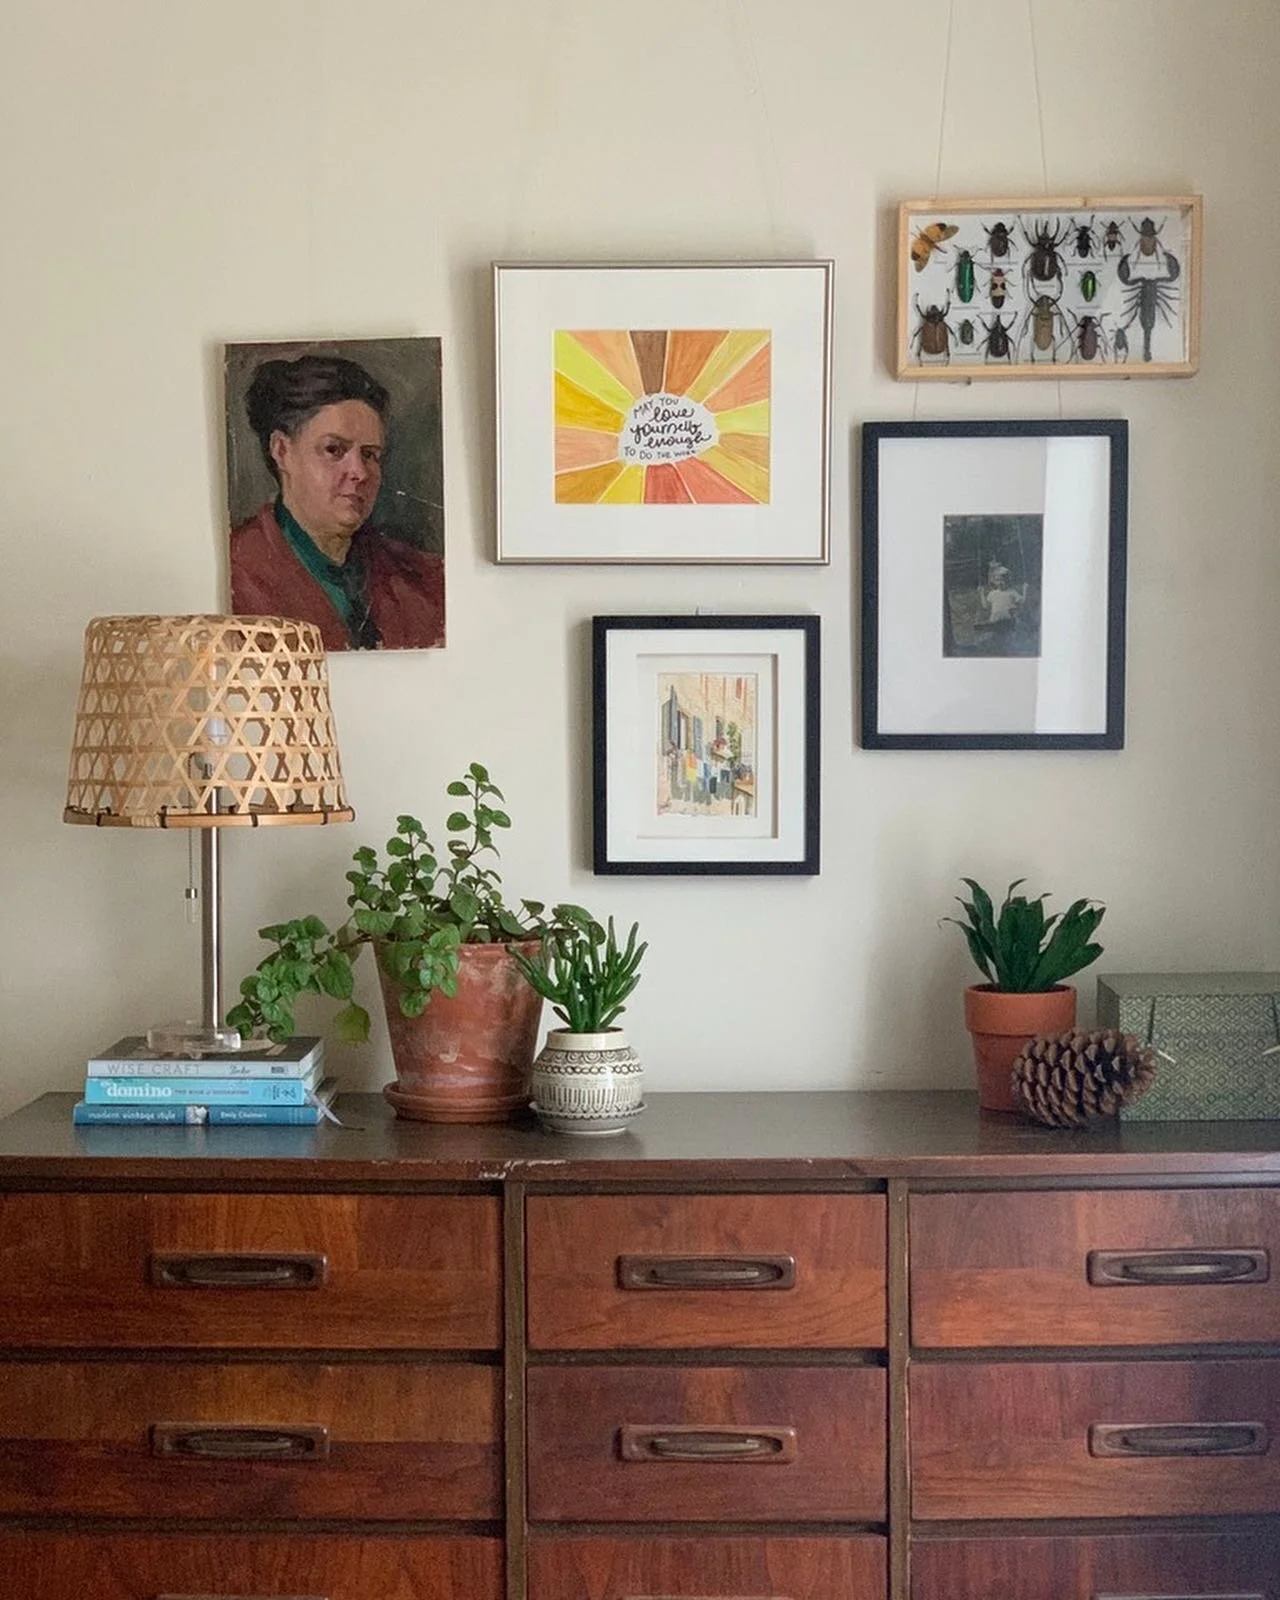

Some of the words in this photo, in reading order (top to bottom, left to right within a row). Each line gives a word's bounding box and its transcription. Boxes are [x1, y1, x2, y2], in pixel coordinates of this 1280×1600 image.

[634, 400, 654, 418] MAY
[659, 397, 679, 406] YOU
[649, 406, 695, 422] love
[630, 421, 702, 444] yourself
[643, 431, 712, 449] enough
[624, 446, 636, 456] TO
[639, 450, 653, 460] DO
[107, 1063, 144, 1075] WISE
[151, 1063, 201, 1075] CRAFT
[106, 1082, 172, 1098] domino
